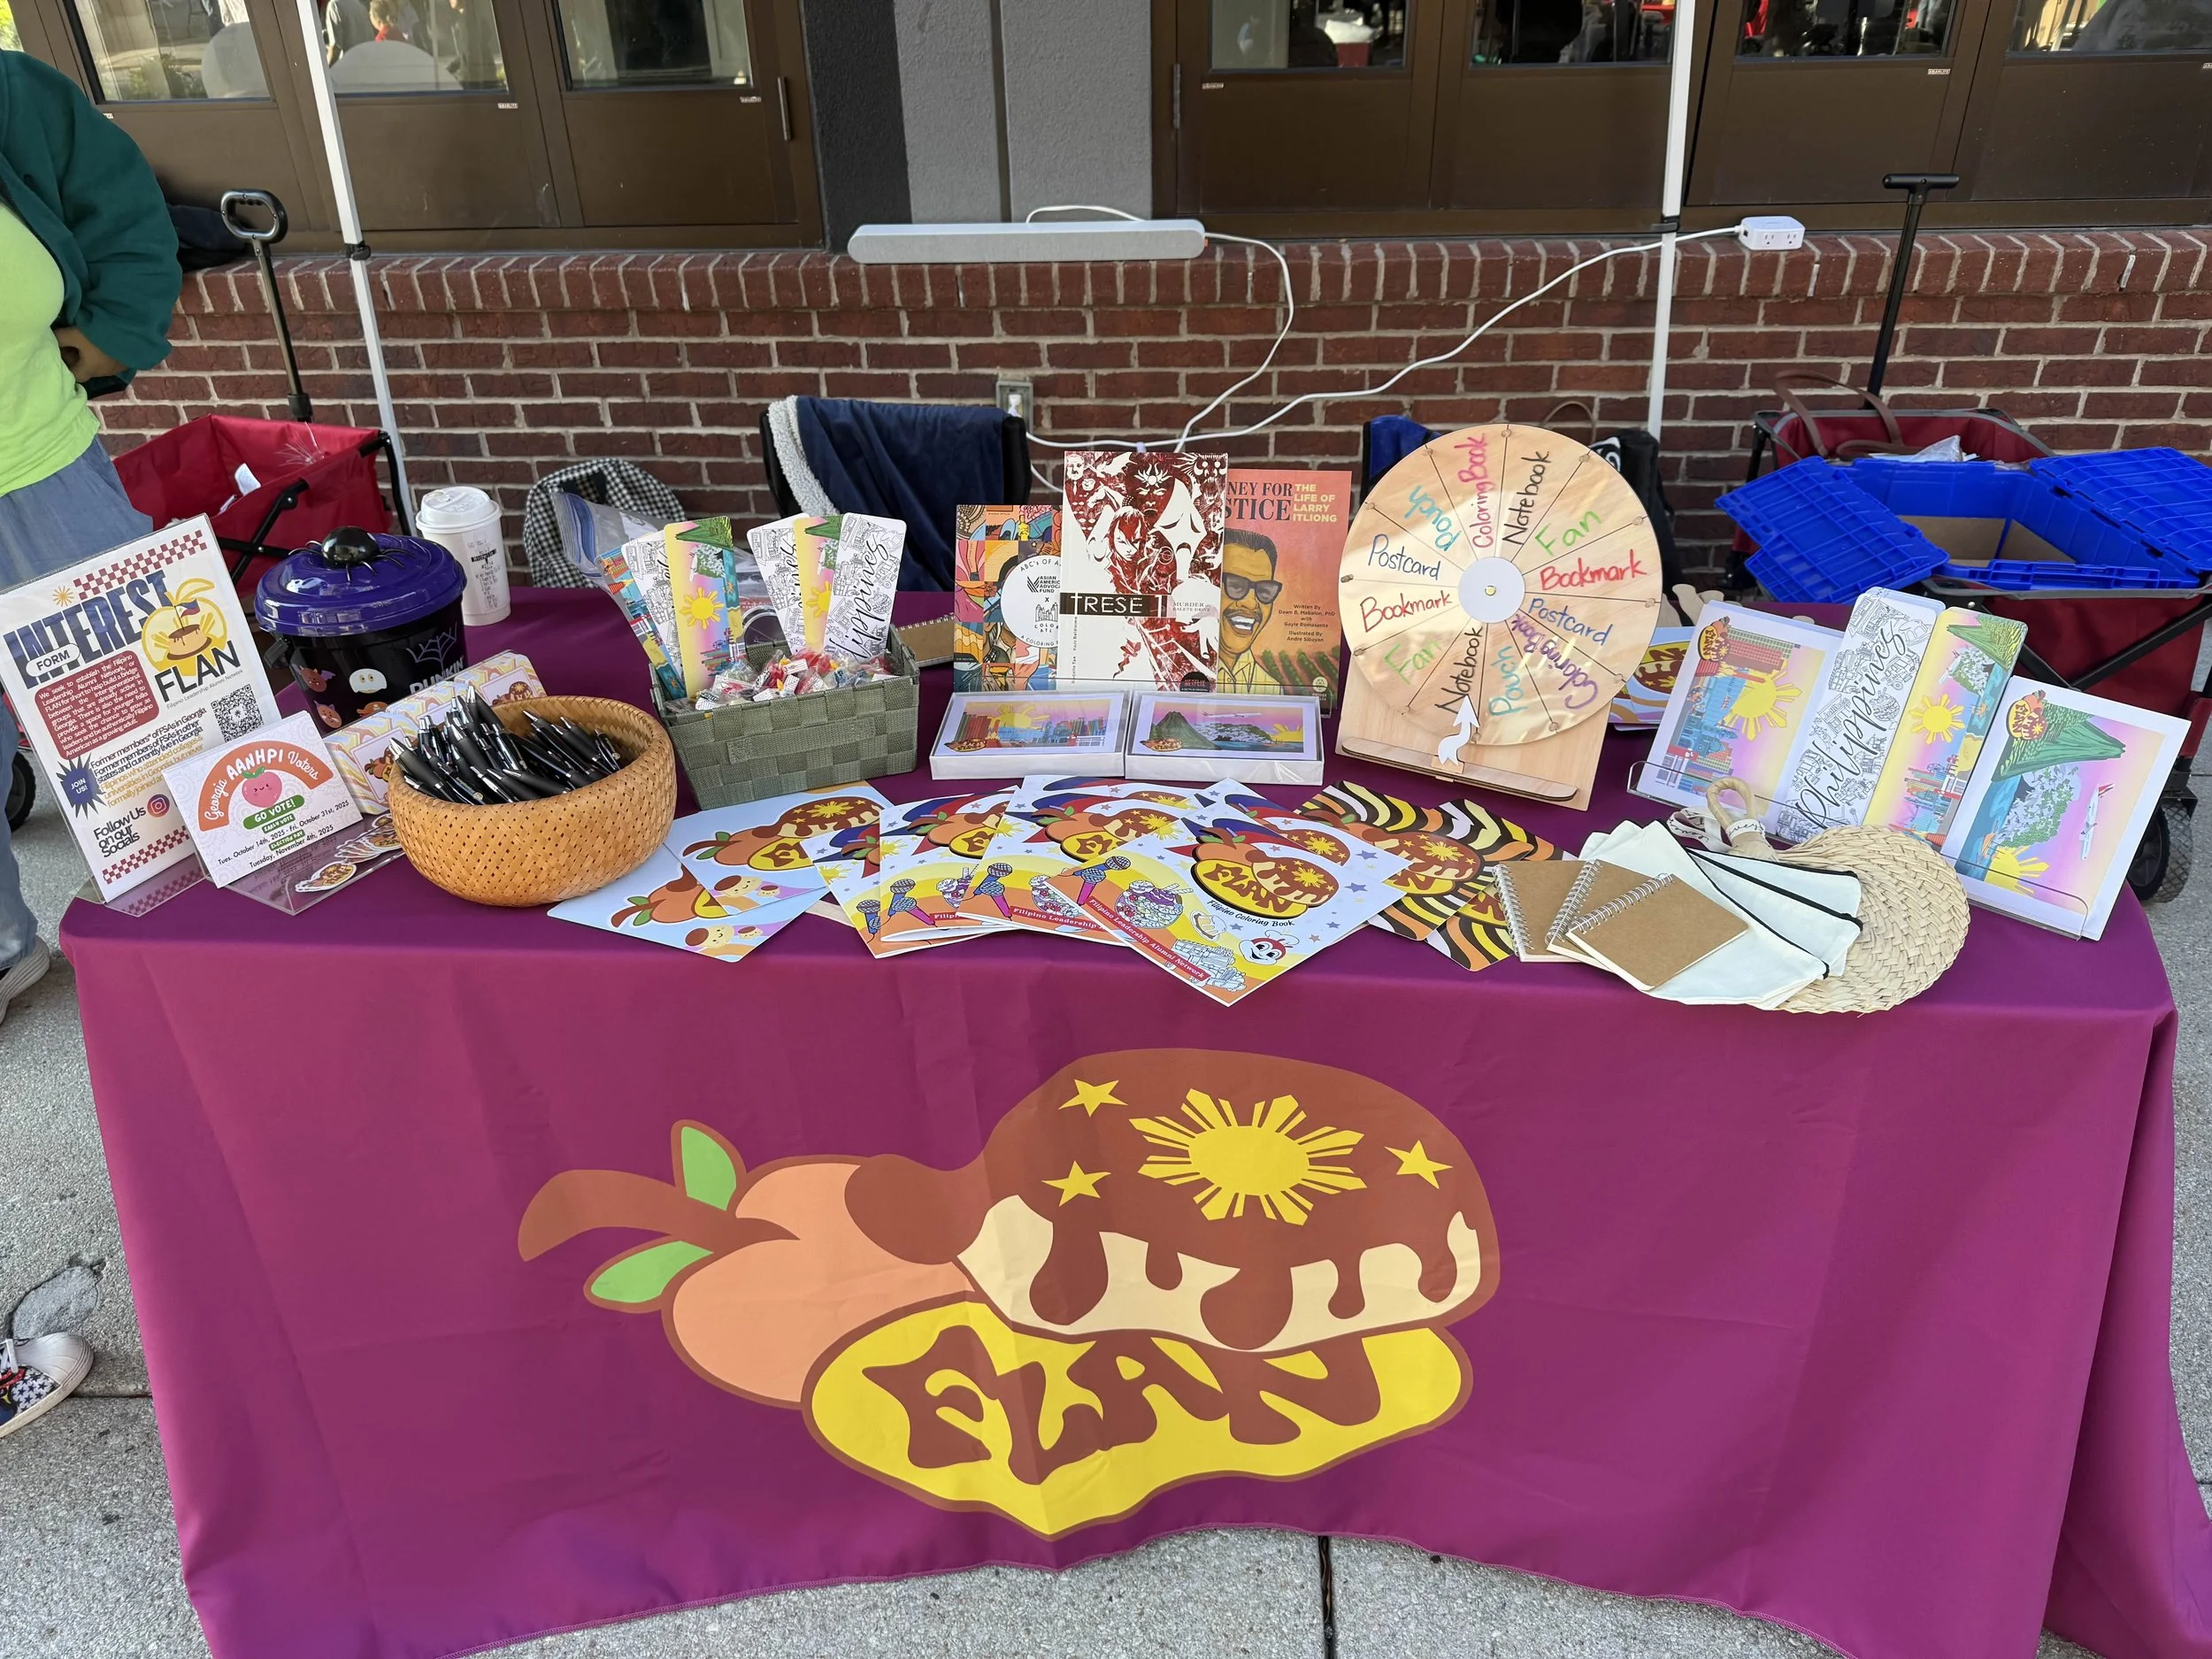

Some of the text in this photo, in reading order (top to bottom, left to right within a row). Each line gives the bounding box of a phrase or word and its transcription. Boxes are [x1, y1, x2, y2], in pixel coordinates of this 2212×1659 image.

[1228, 481, 1293, 496] NEY FOR
[1294, 494, 1317, 503] LIFE
[1294, 503, 1331, 512] LARRY
[1455, 433, 1496, 549] Coloring Book
[1502, 449, 1552, 546] Notebook
[1403, 485, 1463, 552] Pouch
[1534, 509, 1604, 557] Fan
[1367, 533, 1442, 581] Postcard
[1540, 549, 1647, 590] Bookmark
[1154, 595, 1162, 618] 1
[1359, 589, 1453, 633] Bookmark
[1529, 597, 1614, 647] Postcard
[3, 569, 173, 689] INTEREST
[1025, 637, 1055, 647] COLORING
[36, 649, 71, 671] FORM
[51, 684, 65, 694] seek
[75, 669, 100, 683] establish
[112, 655, 132, 666] Filipino
[155, 640, 241, 703] FLAN
[1383, 638, 1443, 685] Fan
[1434, 626, 1483, 715] Notebook
[1488, 645, 1531, 718] Pouch
[42, 688, 73, 706] Leadership
[77, 676, 96, 690] Alumni
[44, 701, 61, 712] FLAN
[69, 690, 85, 701] short
[89, 682, 104, 691] help
[102, 675, 117, 686] build
[119, 667, 137, 678] bridge
[47, 704, 73, 718] between
[50, 712, 71, 726] groups
[72, 706, 85, 715] that
[97, 690, 117, 703] already
[119, 682, 135, 693] active
[166, 669, 242, 709] Filipino Leadership Alumni Network
[89, 752, 116, 769] Former
[151, 728, 158, 738] of
[180, 707, 206, 723] Georgia
[93, 759, 119, 777] Former
[119, 743, 152, 764] members
[151, 738, 159, 747] of
[181, 719, 199, 733] other
[1794, 624, 1906, 831] Philippines
[96, 769, 119, 783] states
[118, 760, 132, 772] and
[131, 745, 162, 766] currently
[159, 741, 173, 751] live
[177, 726, 203, 741] Georgia
[71, 778, 87, 790] JOIN
[75, 785, 88, 795] US!
[204, 748, 319, 821] Georgia AANHPI Voters
[93, 806, 147, 841] Follow Us
[218, 852, 233, 865] Tues.
[233, 844, 254, 857] October
[255, 837, 270, 846] 14th,
[270, 828, 285, 840] 2025
[298, 814, 319, 826] October
[320, 808, 334, 817] 31st,
[334, 799, 349, 810] 2025
[254, 798, 296, 822] GO VOTE!
[280, 814, 293, 824] VOTE
[98, 824, 133, 849] on our
[101, 832, 141, 858] Socials
[249, 854, 275, 869] Tuesday,
[275, 839, 306, 856] November
[318, 824, 334, 836] 2025
[1202, 863, 1287, 913] FLAN
[1013, 907, 1097, 929] Filipino Leadership
[1206, 899, 1235, 918] Filipino
[1234, 912, 1270, 927] Coloring
[1089, 898, 1206, 979] Filipino Leadership Alumni Network
[862, 1323, 1382, 1486] FLAN
